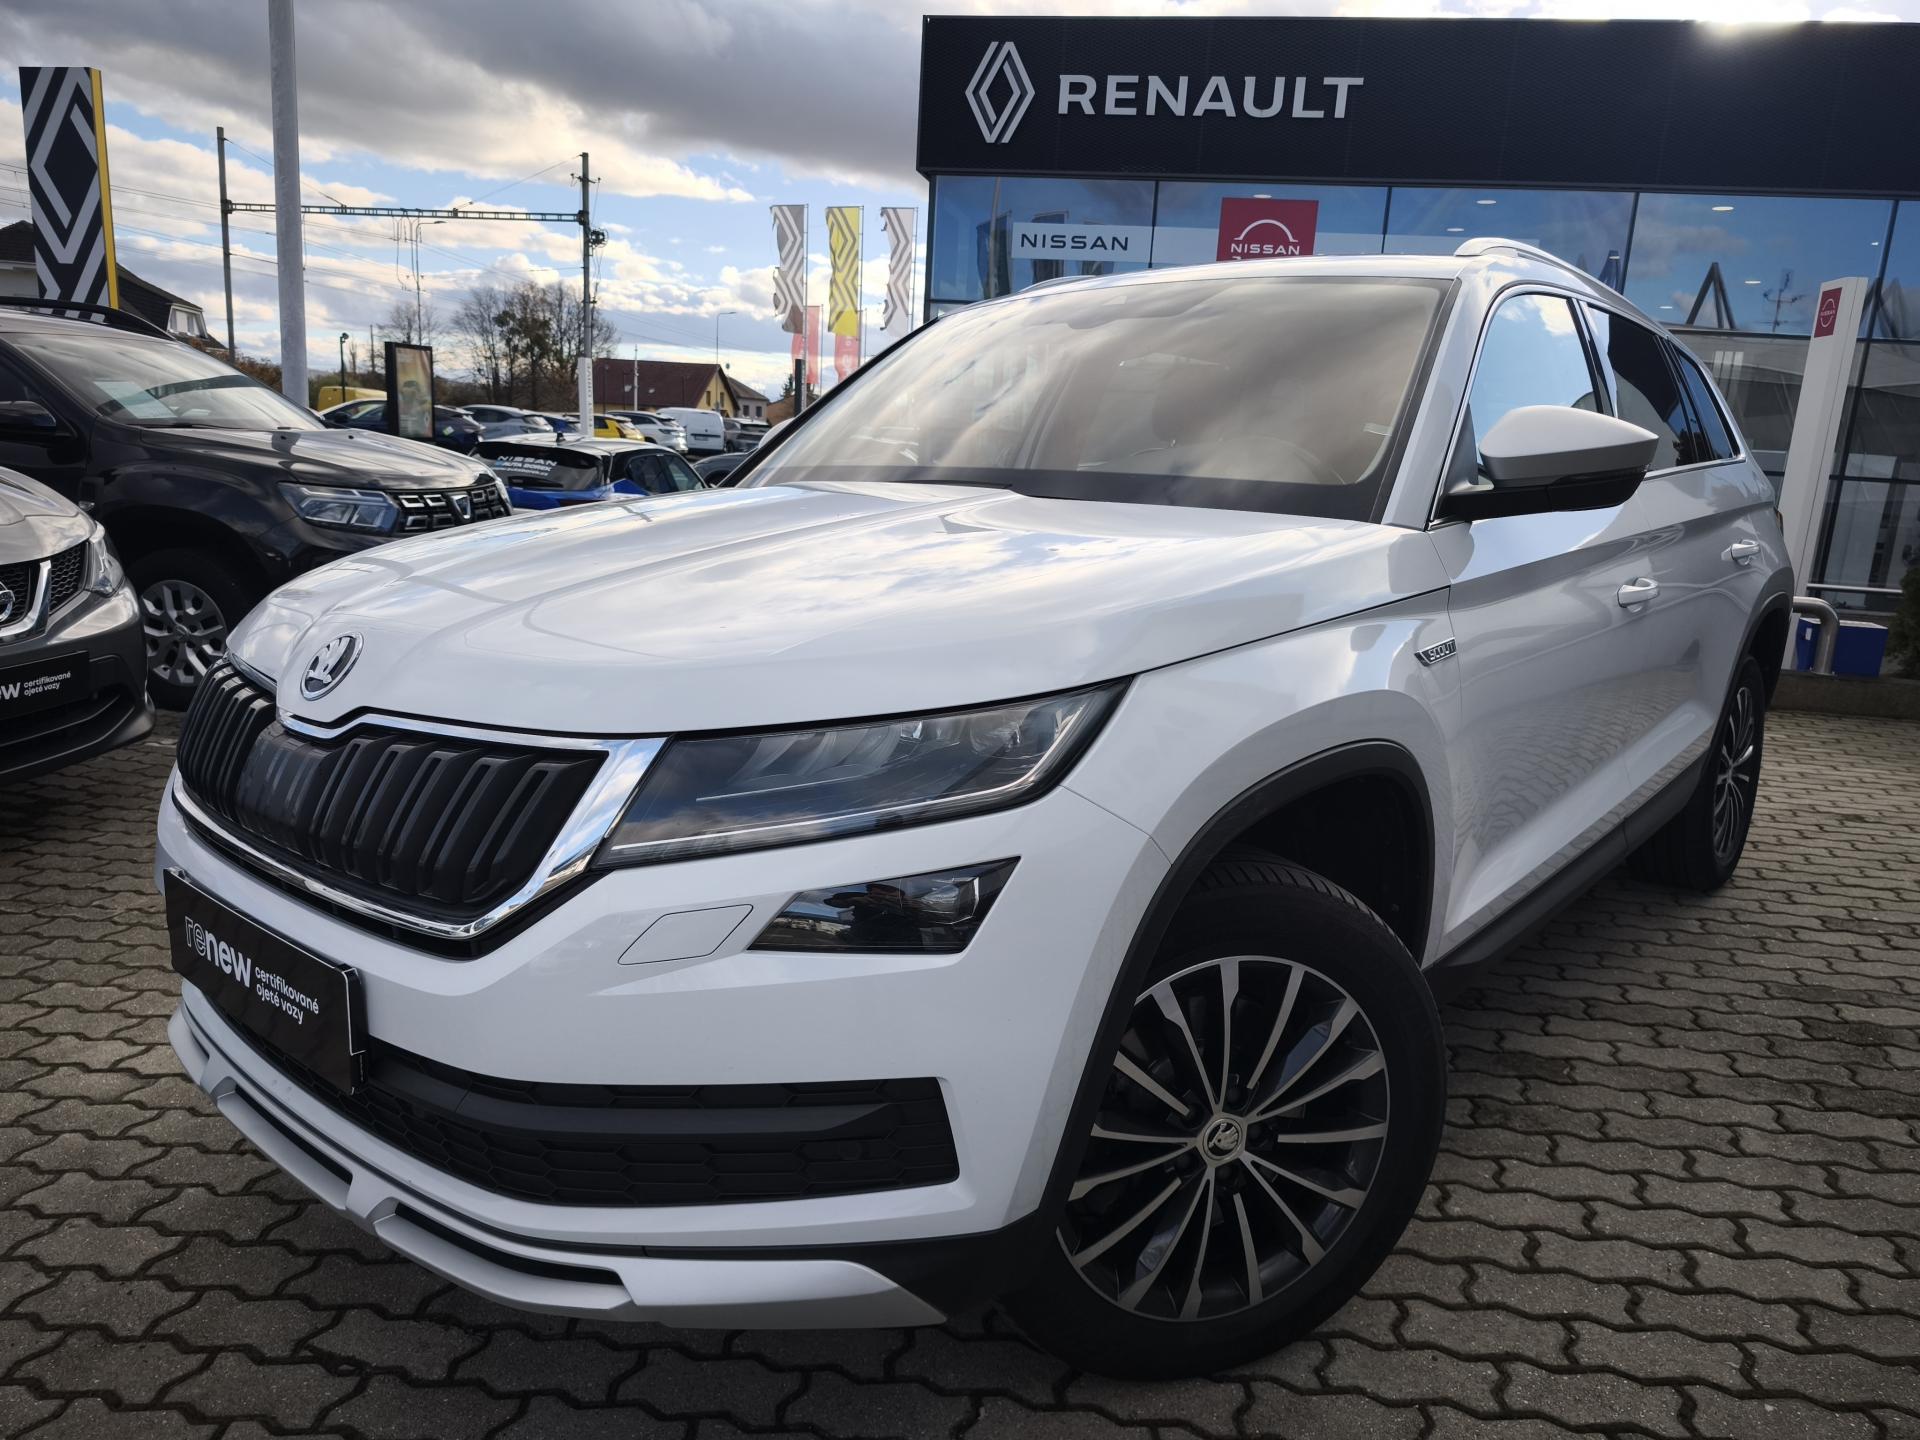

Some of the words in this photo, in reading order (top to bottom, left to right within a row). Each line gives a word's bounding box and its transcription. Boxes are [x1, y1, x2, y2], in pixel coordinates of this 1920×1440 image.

[1058, 74, 1365, 118] RENAULT
[1020, 233, 1129, 251] NISSAN
[1230, 243, 1300, 256] NISSAN
[498, 455, 557, 466] NISSAN
[1429, 641, 1456, 661] SCOUT
[24, 671, 71, 688] certifikované
[24, 684, 43, 696] ojeté
[43, 682, 61, 691] vozy
[184, 915, 252, 989] renew
[255, 966, 319, 1015] certifikované
[256, 983, 280, 1008] ojeté
[281, 1001, 304, 1025] vozy
